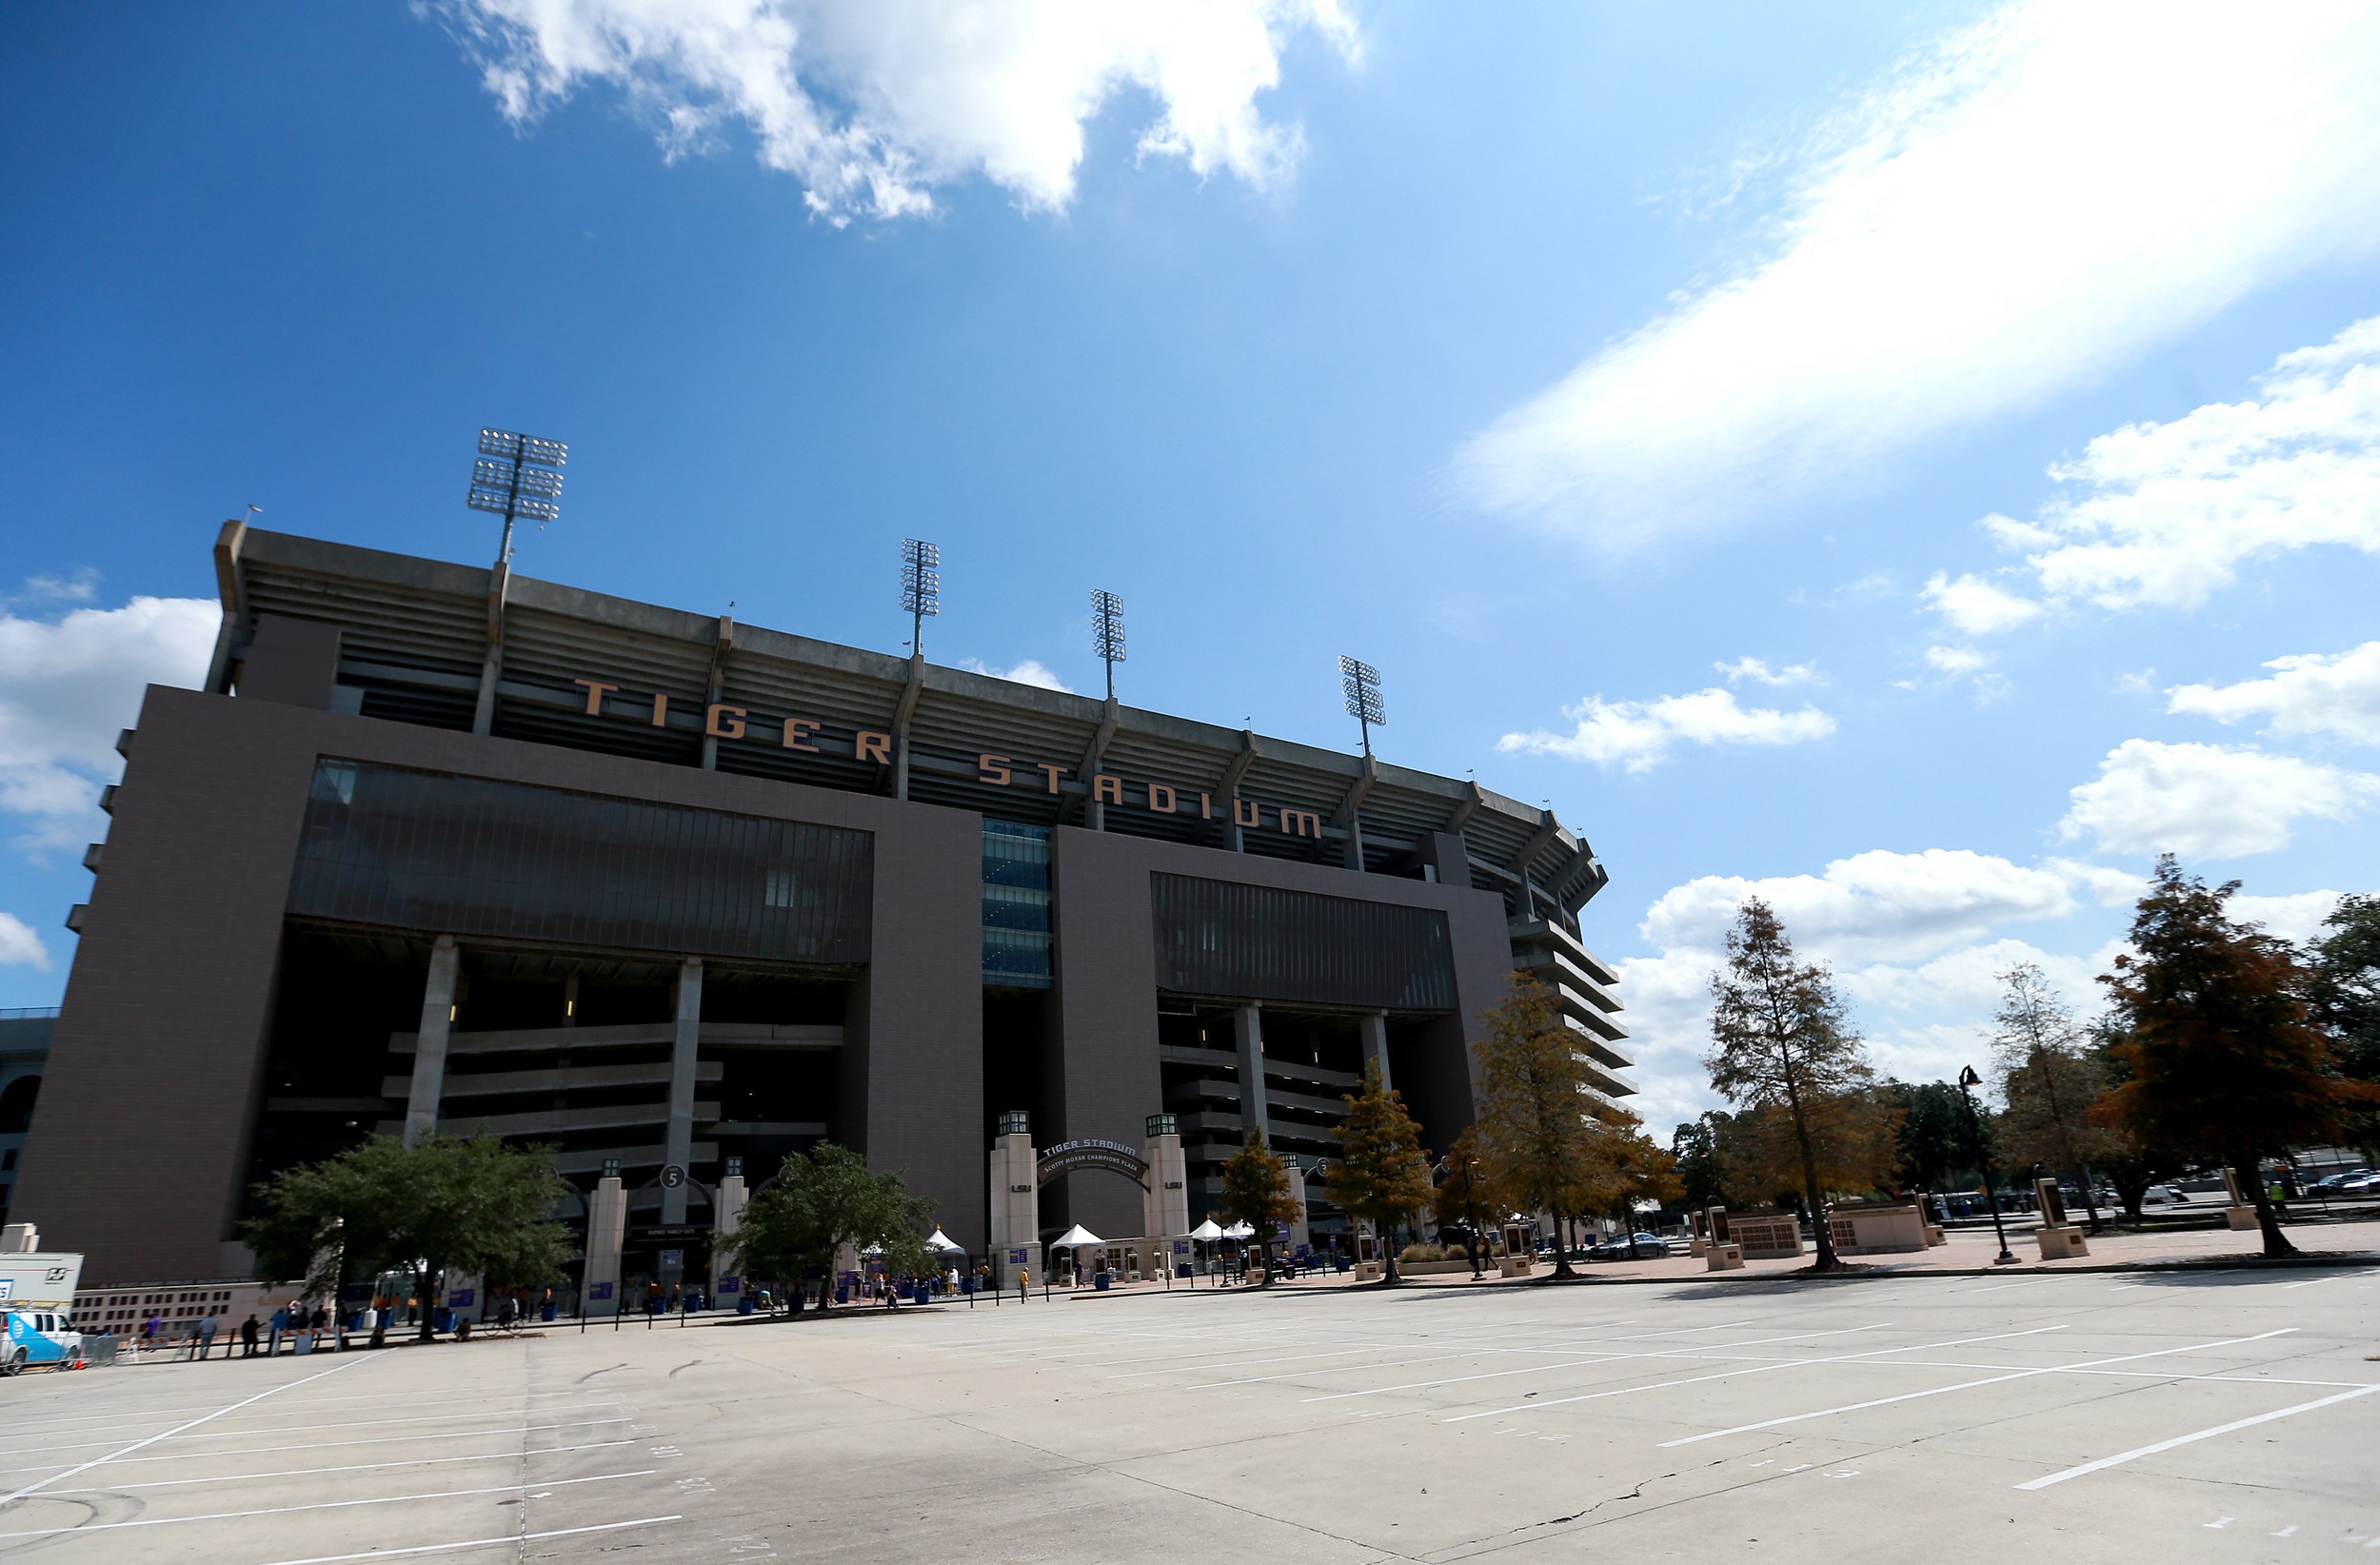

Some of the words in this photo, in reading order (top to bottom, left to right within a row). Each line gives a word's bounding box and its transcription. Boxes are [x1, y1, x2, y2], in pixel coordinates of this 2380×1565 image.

[573, 677, 891, 765] TIGER
[978, 753, 1321, 839] STADIUM
[1043, 1139, 1080, 1158] TIGER
[1083, 1139, 1136, 1157] STADIUM
[1044, 1160, 1065, 1174] SCOTTY
[1065, 1155, 1086, 1165] MORAN
[1087, 1154, 1121, 1165] CHAMPIONS
[1121, 1160, 1138, 1173] PLAZA
[668, 1173, 678, 1186] 5
[1165, 1181, 1182, 1190] LSU
[1011, 1184, 1032, 1193] LSU
